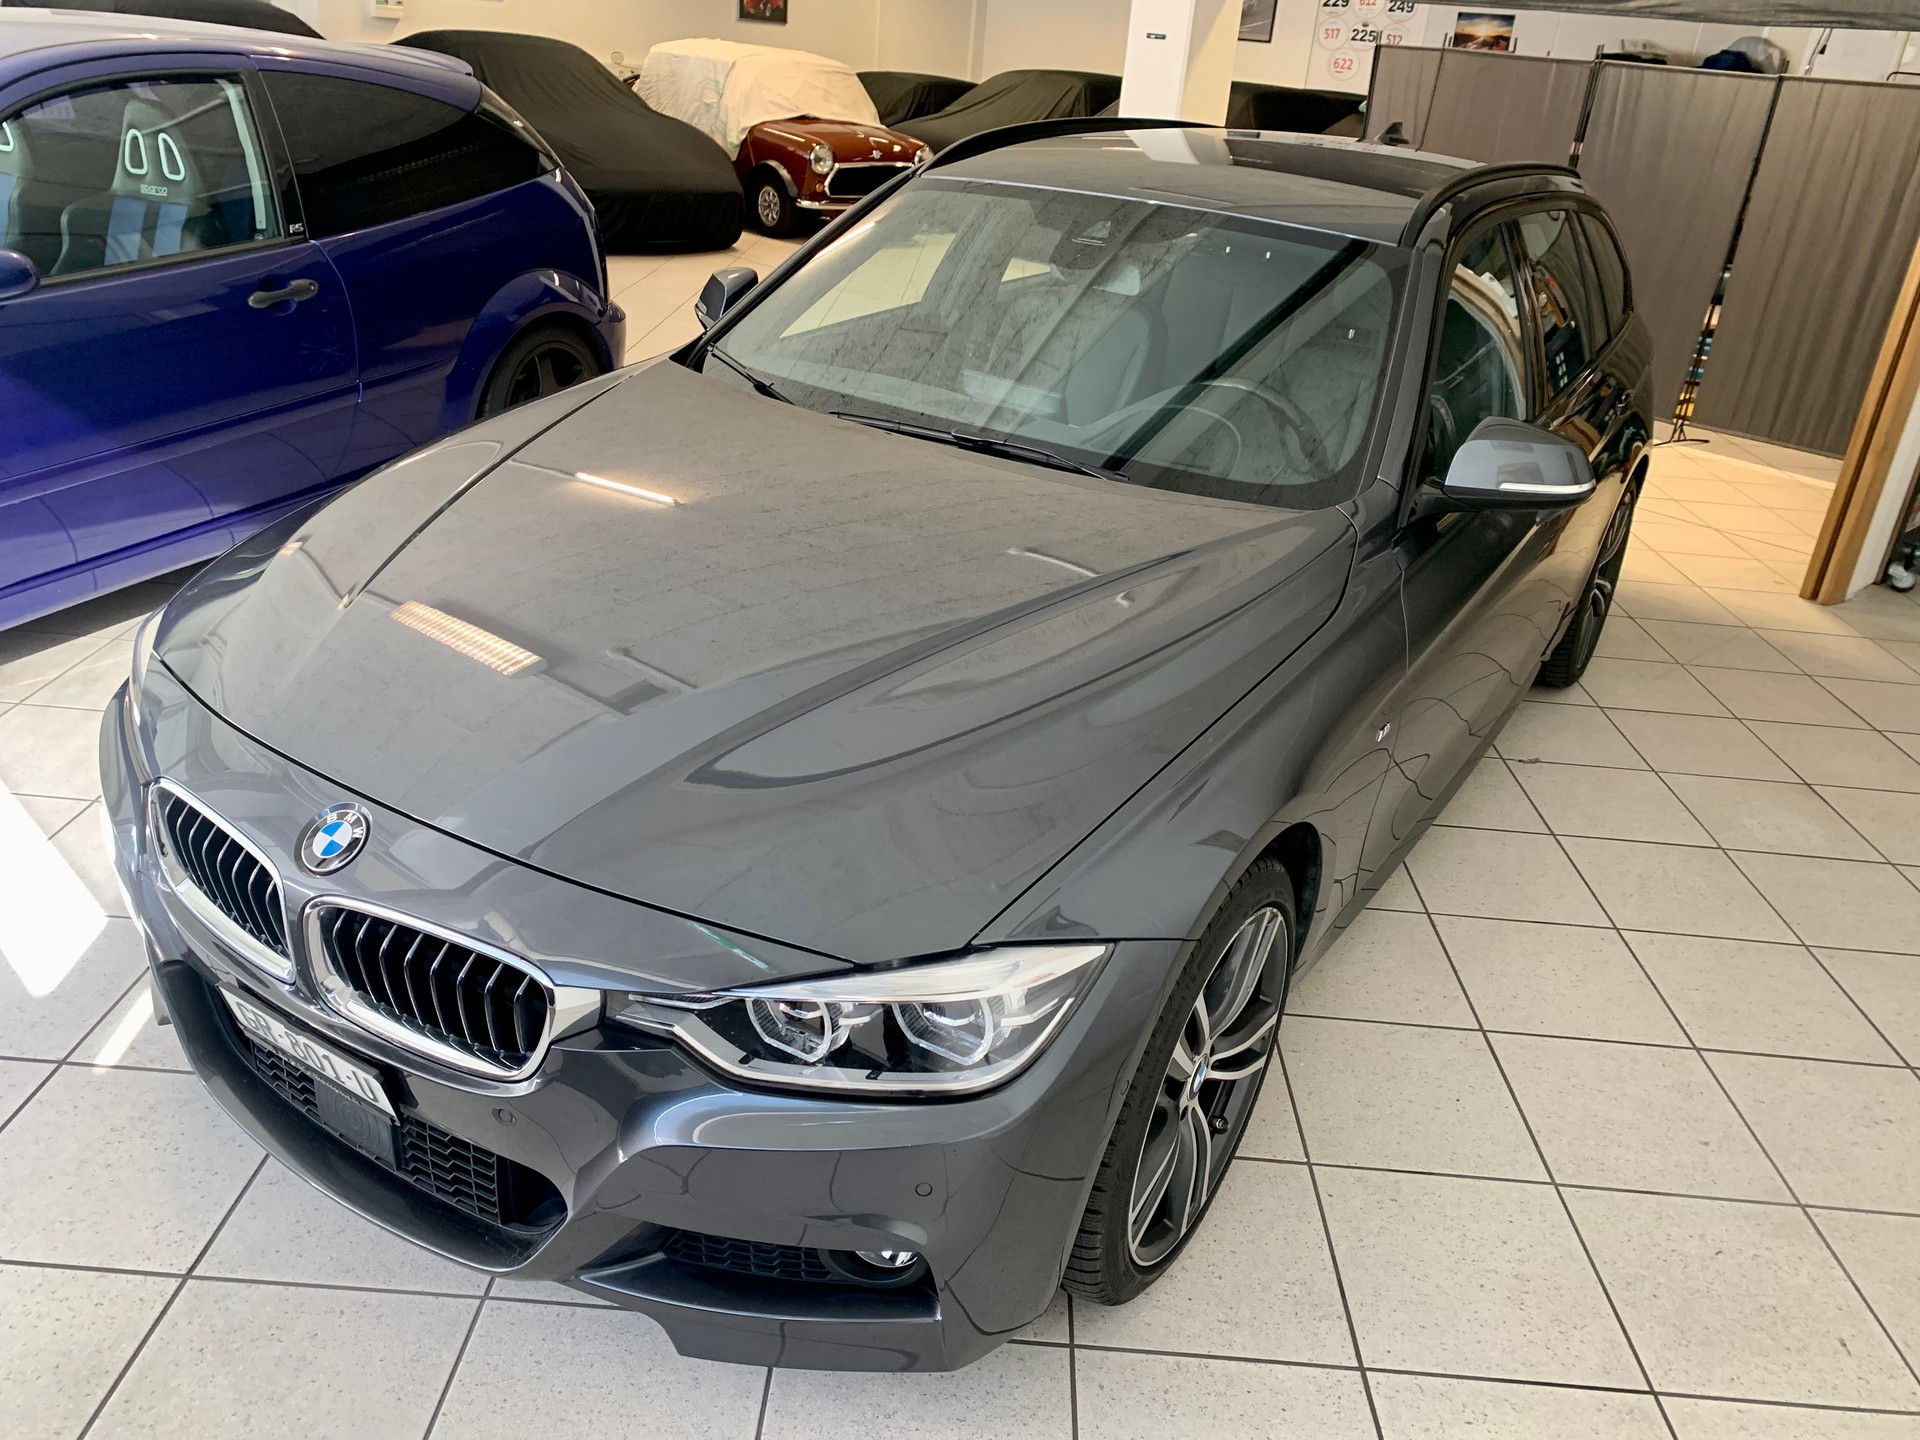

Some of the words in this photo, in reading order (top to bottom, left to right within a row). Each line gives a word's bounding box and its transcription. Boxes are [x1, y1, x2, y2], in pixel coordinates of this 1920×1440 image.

[1388, 0, 1415, 13] 249
[1324, 28, 1341, 40] 517
[1350, 28, 1377, 43] 225
[1333, 57, 1354, 71] 622
[289, 222, 304, 234] RS
[326, 812, 364, 839] BMW
